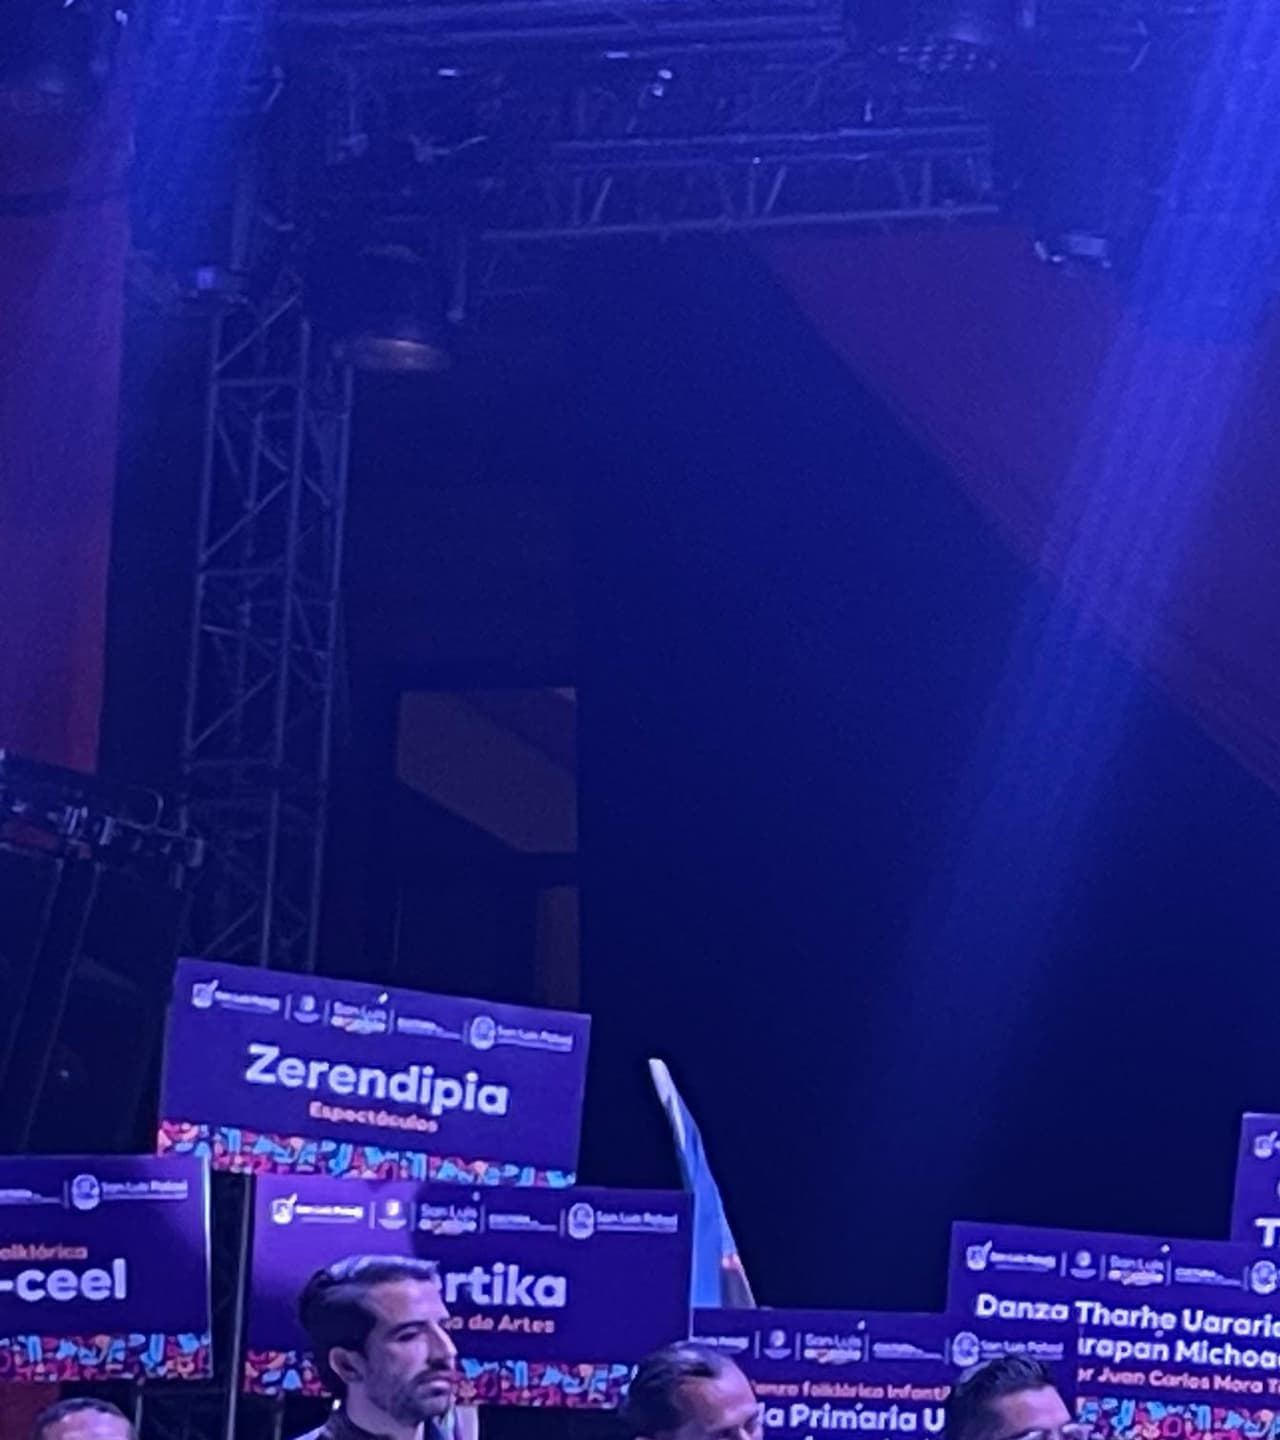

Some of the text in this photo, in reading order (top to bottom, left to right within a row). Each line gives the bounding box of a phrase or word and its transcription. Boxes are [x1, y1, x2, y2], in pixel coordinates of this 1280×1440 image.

[245, 1043, 510, 1116] Zerendipia
[309, 1101, 438, 1133] Espectáculos
[443, 1261, 567, 1308] rtika
[468, 1313, 494, 1331] de
[497, 1314, 555, 1334] Artes
[975, 1293, 1069, 1321] Danza
[1075, 1300, 1177, 1330] Tharhe
[752, 1381, 799, 1397] anza
[1098, 1366, 1146, 1385] Juan
[1149, 1369, 1211, 1390] Carlos
[1213, 1374, 1264, 1394] Mora
[790, 1402, 917, 1431] Primaria
[923, 1407, 946, 1432] U
